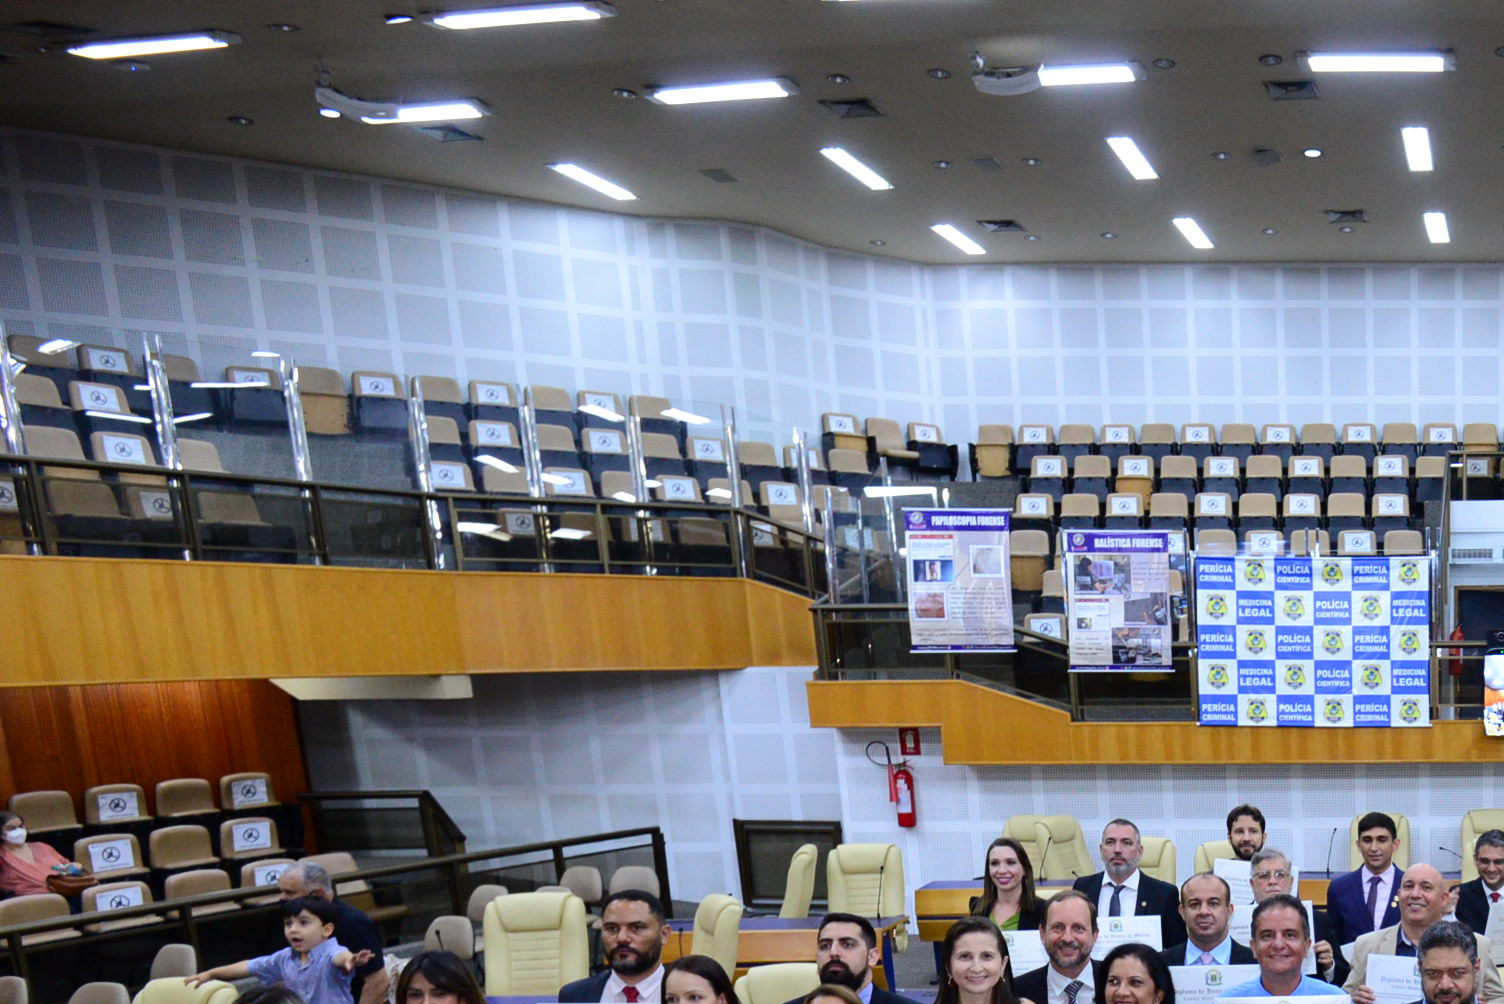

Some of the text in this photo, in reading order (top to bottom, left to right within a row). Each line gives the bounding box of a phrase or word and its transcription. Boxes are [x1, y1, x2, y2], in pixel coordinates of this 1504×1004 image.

[931, 516, 1005, 526] PAPILOSCOPIA FORENSE
[1094, 537, 1164, 548] BALÍSTICA FORENSE
[1199, 563, 1233, 573] PERÍCIA
[1276, 564, 1310, 574] POLÍCIA
[1354, 564, 1388, 574] PERÍCIA
[1316, 600, 1350, 609] POLÍCIA
[1238, 608, 1272, 617] LEGAL
[1392, 608, 1426, 617] LEGAL
[1200, 633, 1234, 642] PERÍCIA
[1278, 633, 1310, 643] POLÍCIA
[1354, 634, 1388, 644] PERÍCIA
[1316, 668, 1350, 678] POLÍCIA
[1240, 678, 1274, 686] LEGAL
[1393, 678, 1426, 686] LEGAL
[1202, 702, 1235, 712] PERÍCIA
[1279, 702, 1312, 712] POLÍCIA
[1355, 702, 1388, 712] PERÍCIA
